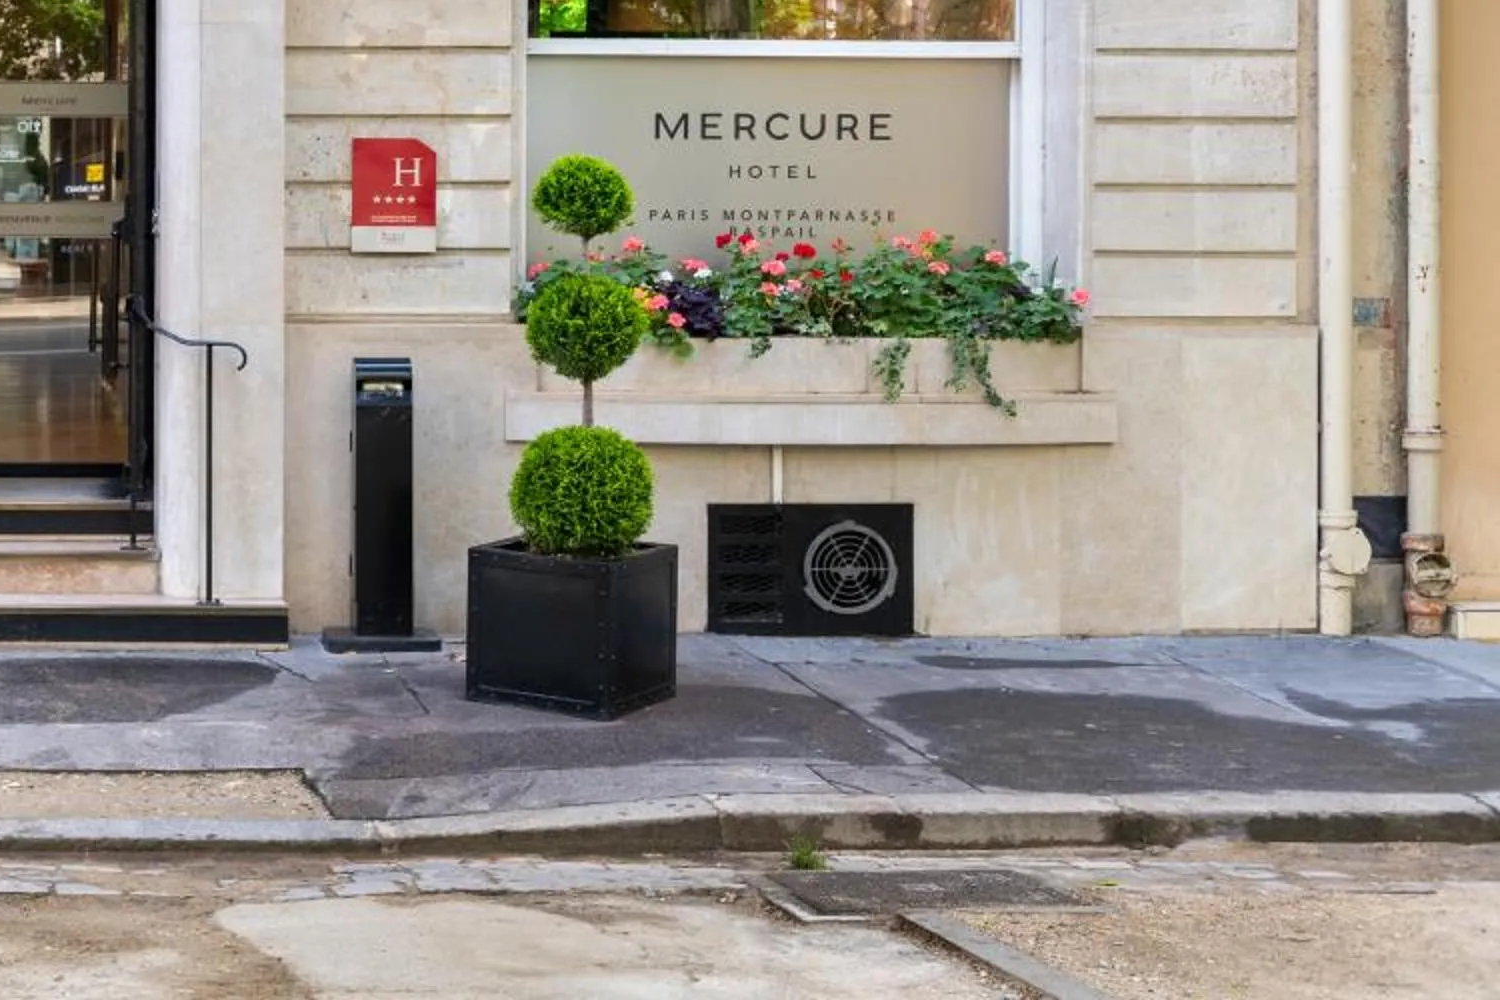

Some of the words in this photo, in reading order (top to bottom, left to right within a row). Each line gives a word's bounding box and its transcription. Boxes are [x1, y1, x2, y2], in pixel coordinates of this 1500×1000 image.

[653, 112, 893, 141] MERCURE
[392, 157, 424, 187] H
[727, 164, 818, 180] HOTEL
[648, 208, 710, 222] PARIS
[722, 208, 897, 223] MONTPARNASSE
[728, 225, 818, 239] RASPAIL
